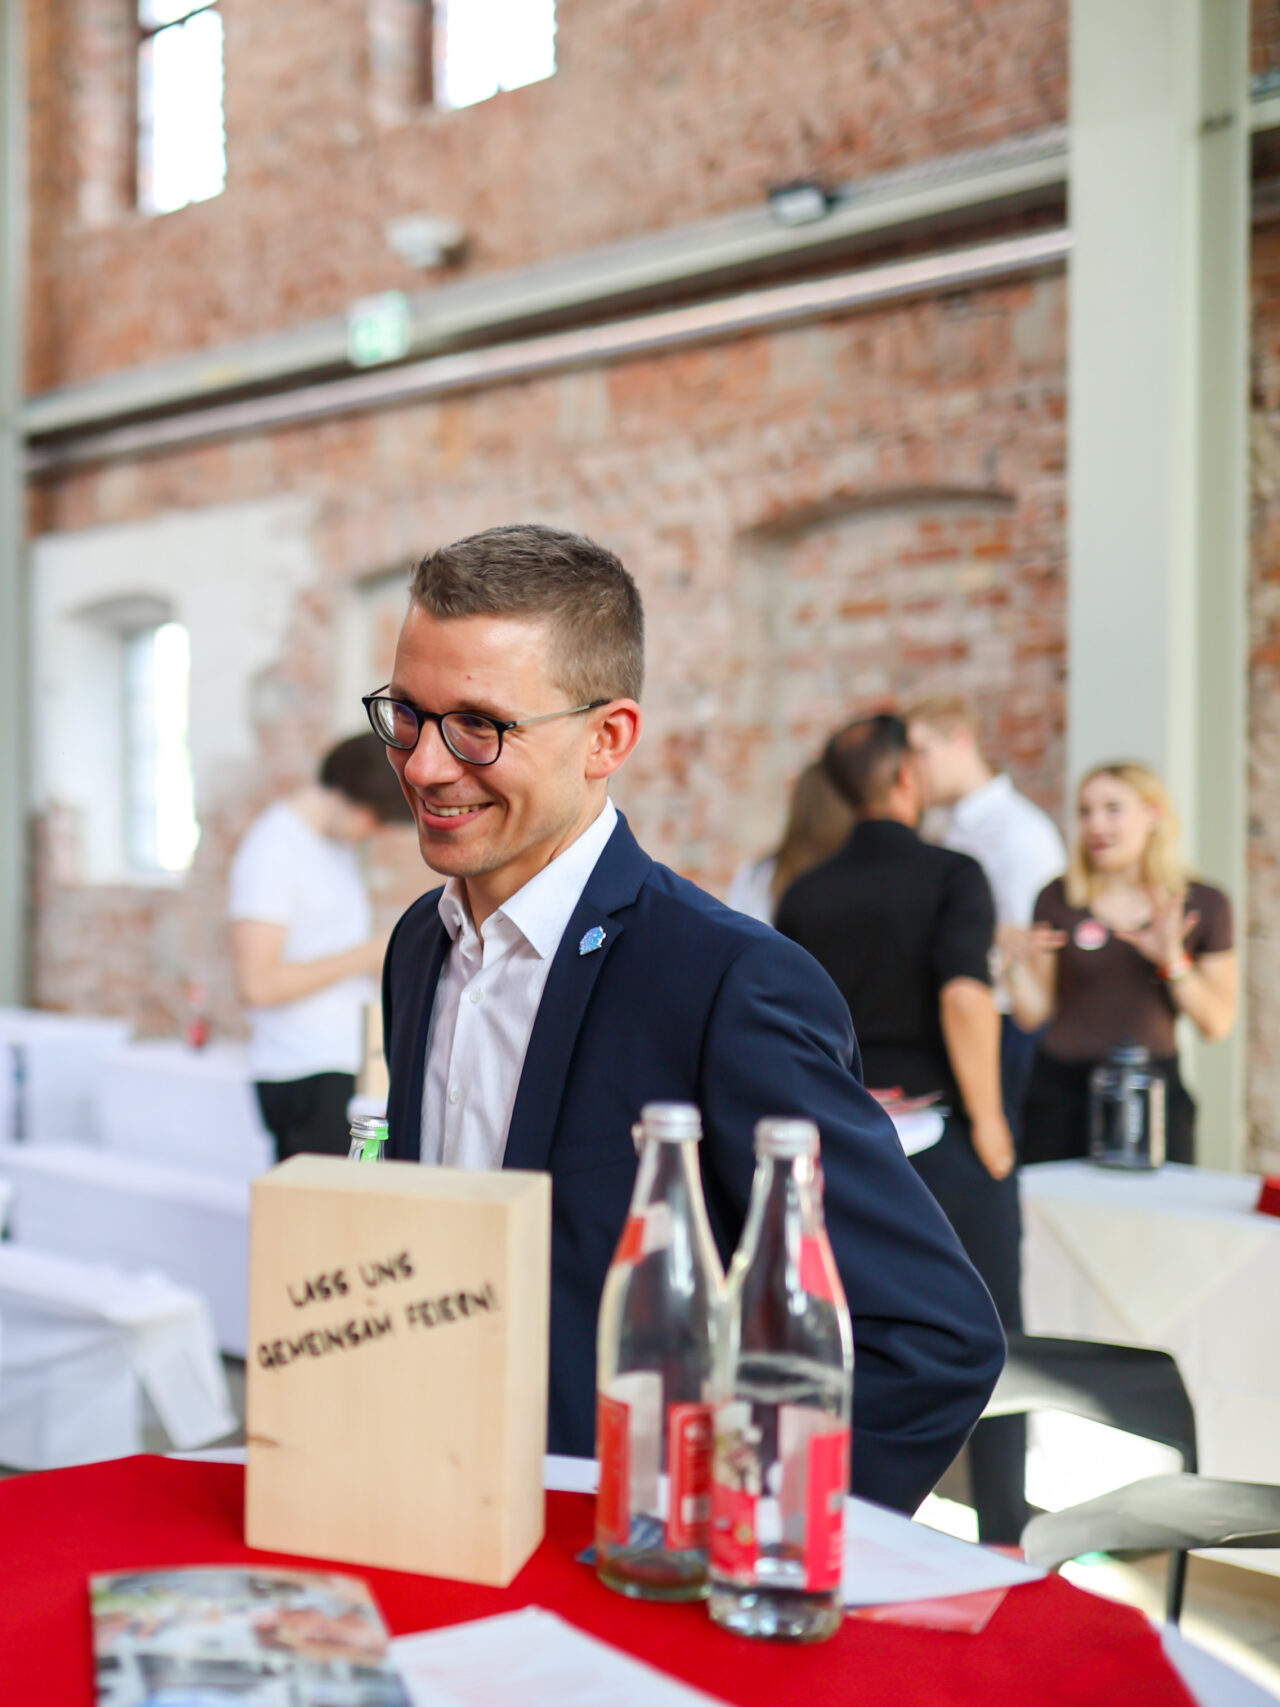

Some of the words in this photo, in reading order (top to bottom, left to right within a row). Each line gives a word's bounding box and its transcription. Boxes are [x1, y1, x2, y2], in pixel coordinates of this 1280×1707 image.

[287, 1269, 349, 1308] LASS
[359, 1251, 414, 1287] UNS
[258, 1313, 392, 1370] GEMEINSAM
[405, 1282, 499, 1329] FEIERN!
